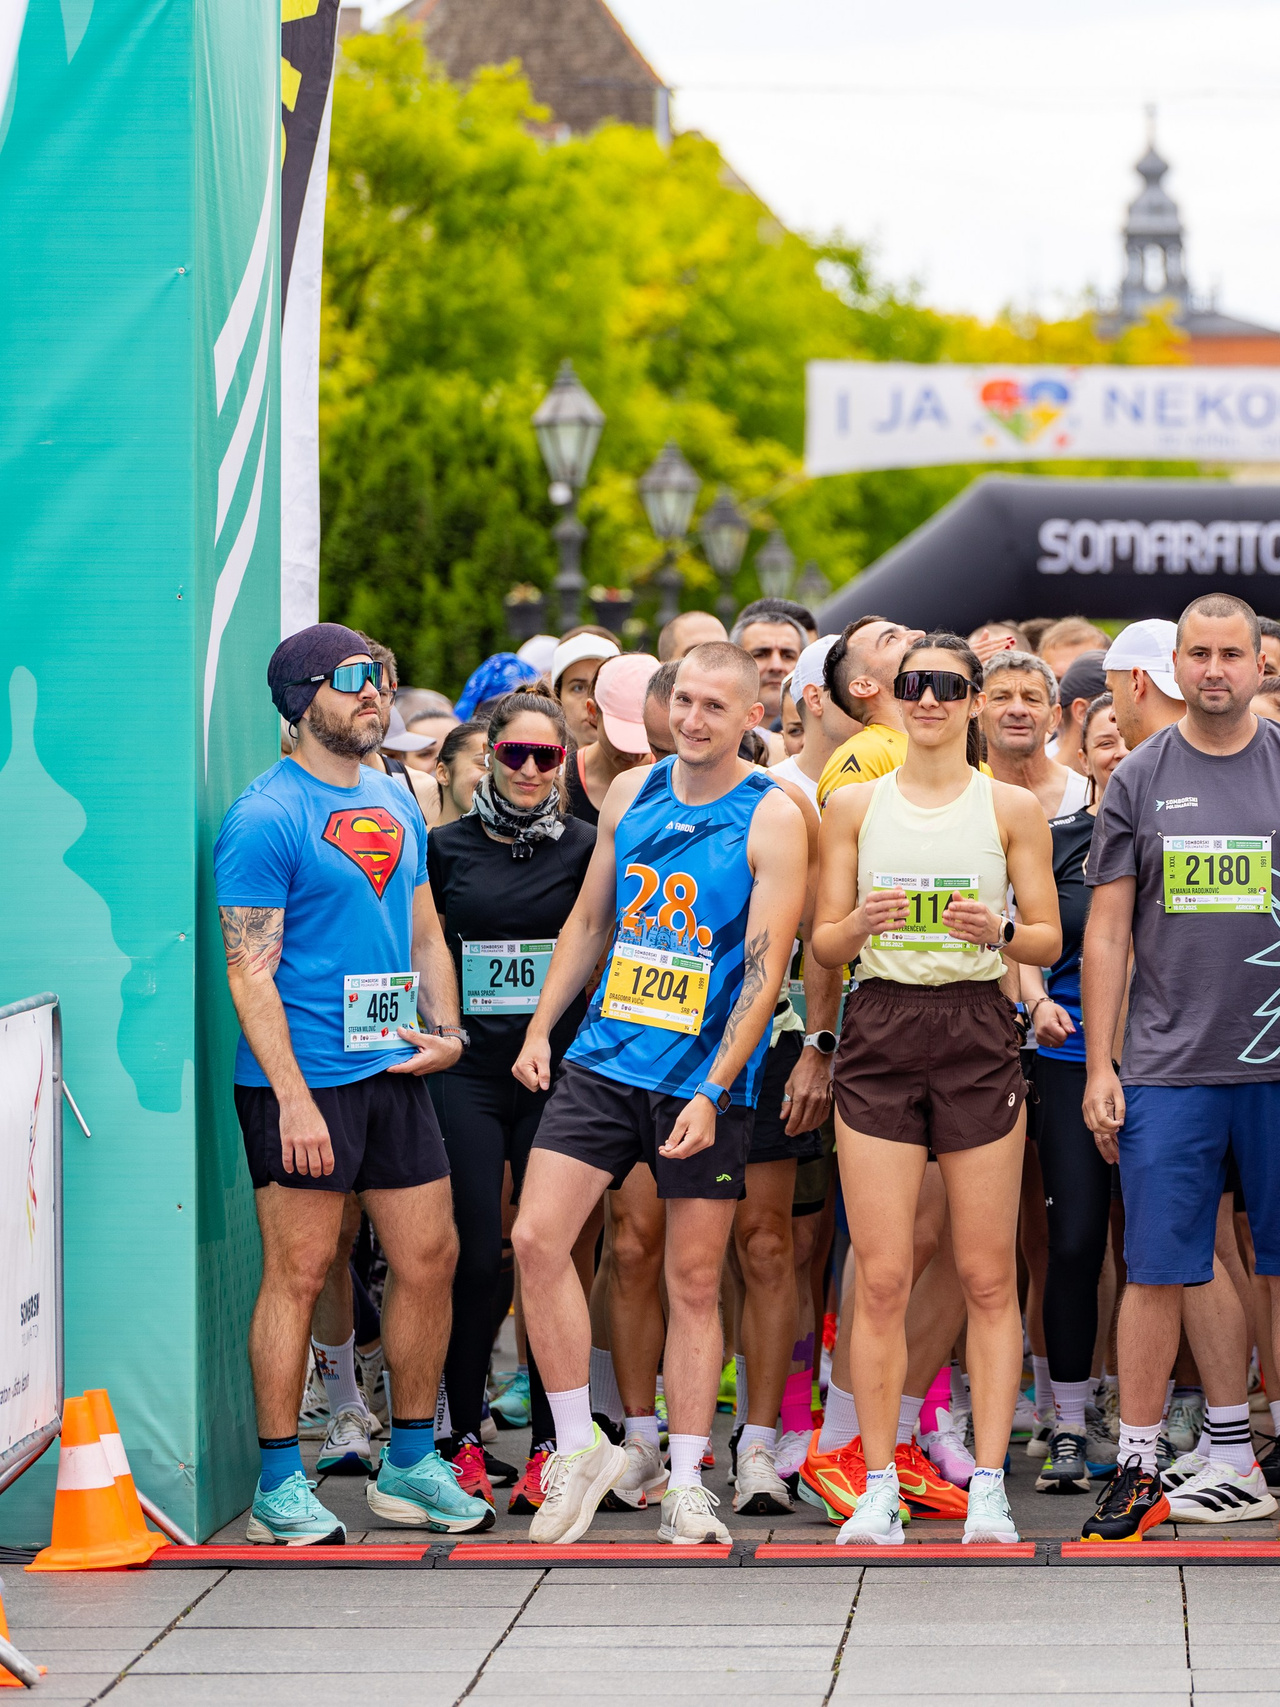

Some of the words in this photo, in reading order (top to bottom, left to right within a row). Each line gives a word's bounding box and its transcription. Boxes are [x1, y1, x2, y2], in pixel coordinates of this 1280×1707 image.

[872, 388, 951, 433] JA
[1165, 797, 1199, 806] SOMBORSKI
[1185, 855, 1250, 886] 2180
[624, 863, 713, 948] 28.
[1192, 887, 1220, 895] RADOJKOVIĆ
[489, 958, 535, 988] 246
[632, 966, 690, 1004] 1204
[481, 988, 496, 997] SPASIĆ
[609, 992, 631, 1003] DRAGOMIR
[367, 993, 399, 1023] 465
[681, 1006, 690, 1015] SRB
